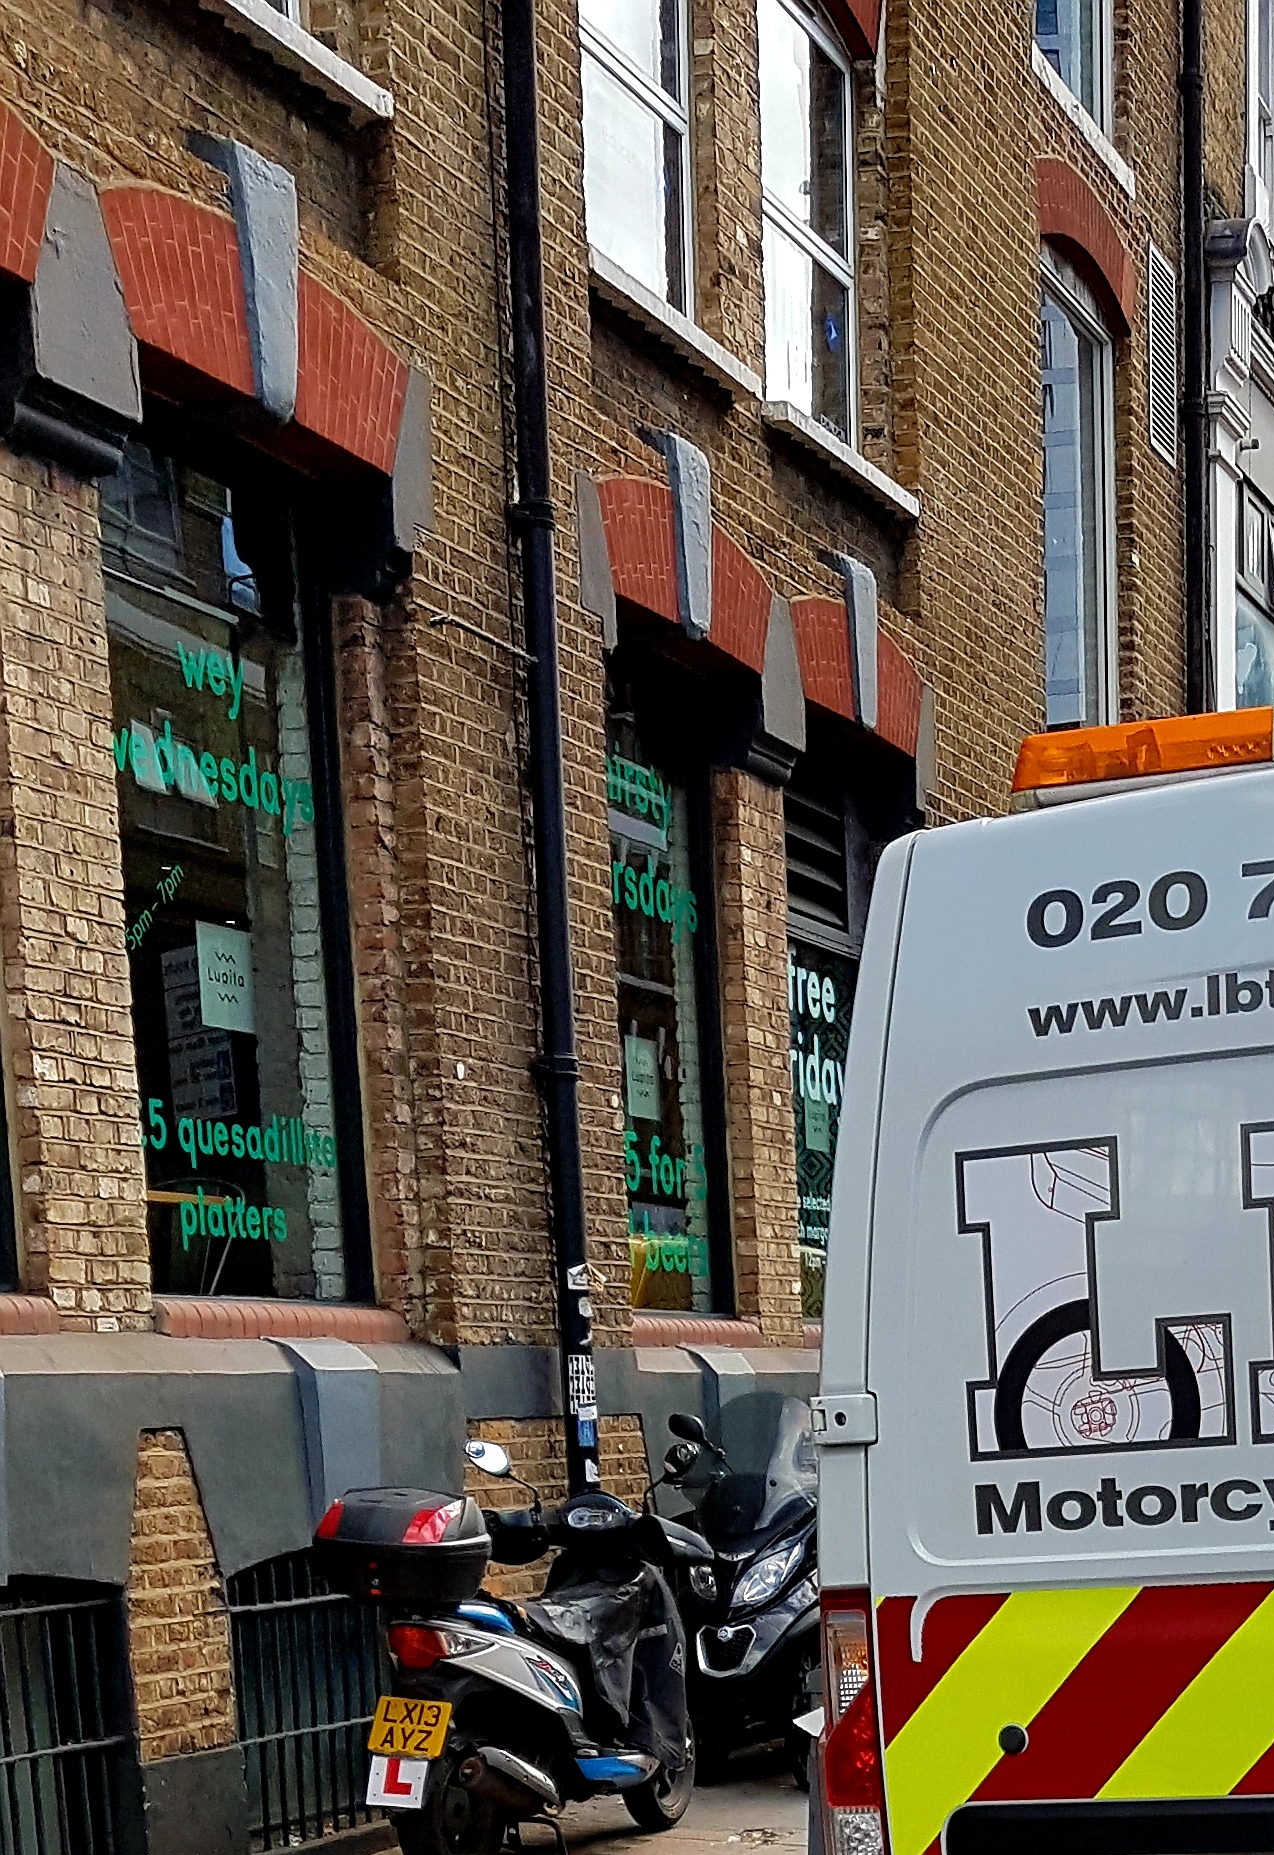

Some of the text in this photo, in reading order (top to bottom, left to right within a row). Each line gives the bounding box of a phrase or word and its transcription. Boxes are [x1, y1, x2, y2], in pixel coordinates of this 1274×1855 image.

[177, 640, 244, 720] wey
[606, 740, 672, 846] irsty
[611, 854, 698, 944] rsdays
[1026, 869, 1208, 950] 020
[788, 943, 836, 1024] free
[789, 1031, 844, 1106] riday
[140, 1097, 167, 1150] 5
[649, 1135, 686, 1199] for
[180, 1185, 288, 1252] platters
[379, 1726, 433, 1753] AYZ
[382, 1700, 442, 1728] LX13
[382, 1757, 413, 1796] L
